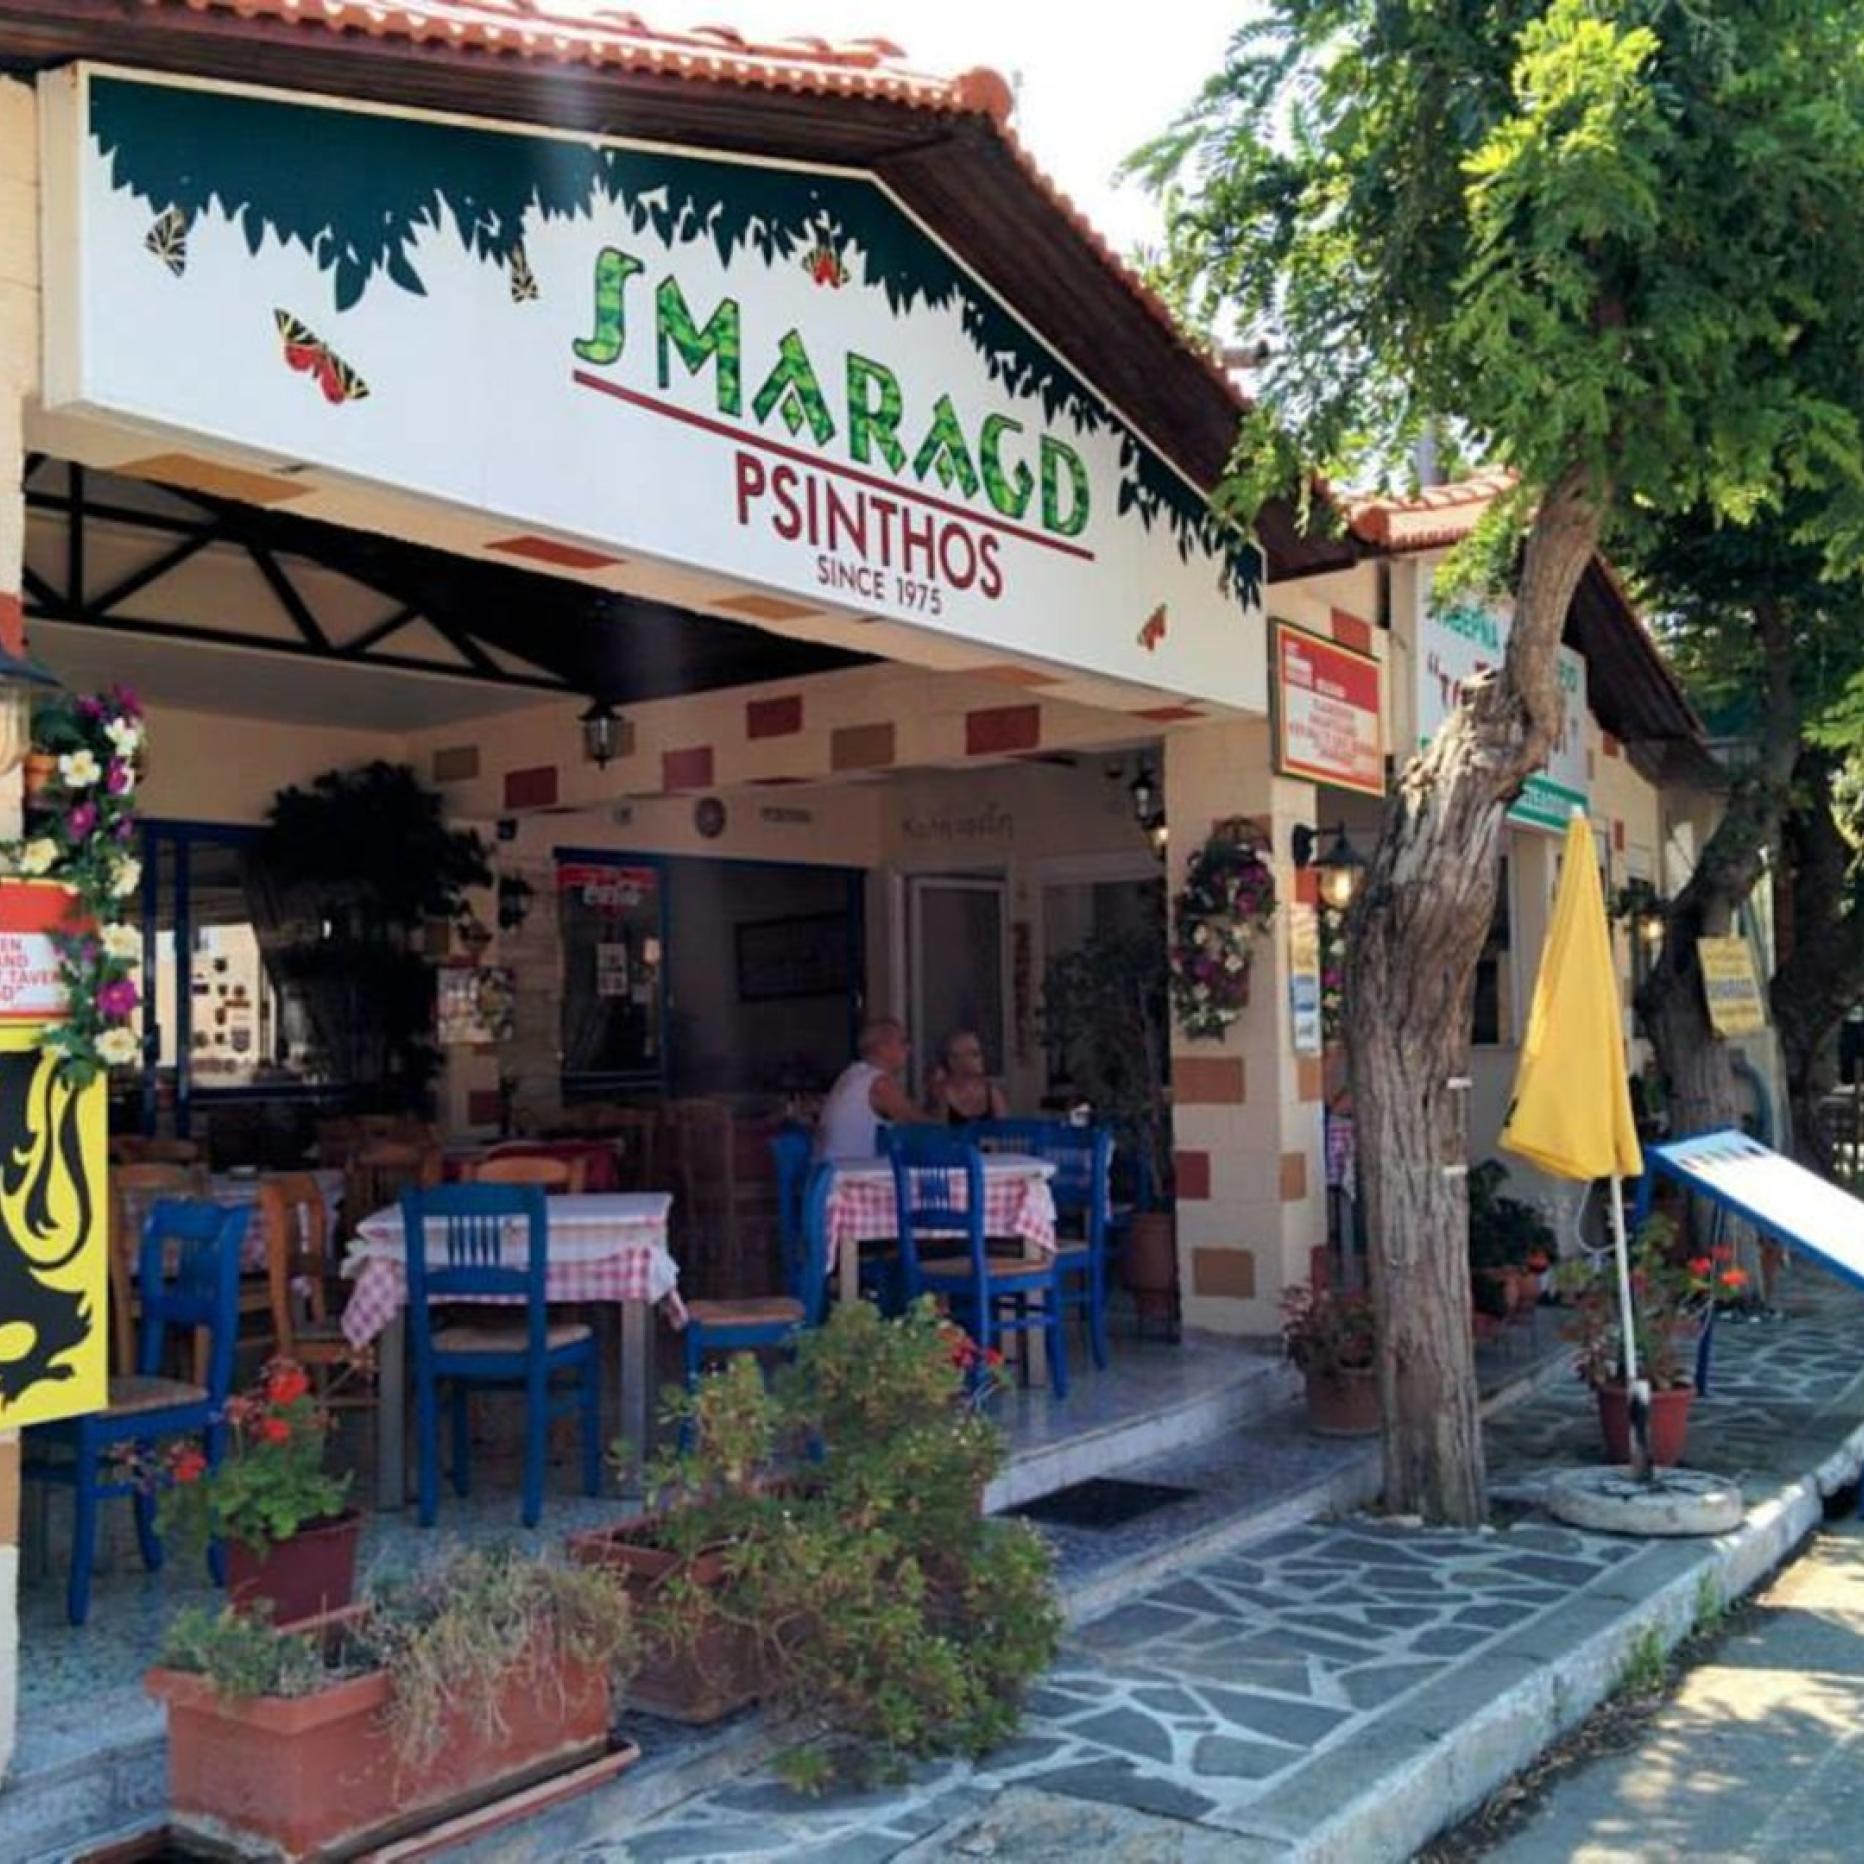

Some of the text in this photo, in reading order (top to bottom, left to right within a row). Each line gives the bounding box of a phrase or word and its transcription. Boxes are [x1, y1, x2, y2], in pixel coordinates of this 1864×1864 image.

[572, 246, 1091, 538] SMARAGD
[735, 450, 1004, 600] PSINTHOS
[817, 554, 943, 615] SINCE 1975
